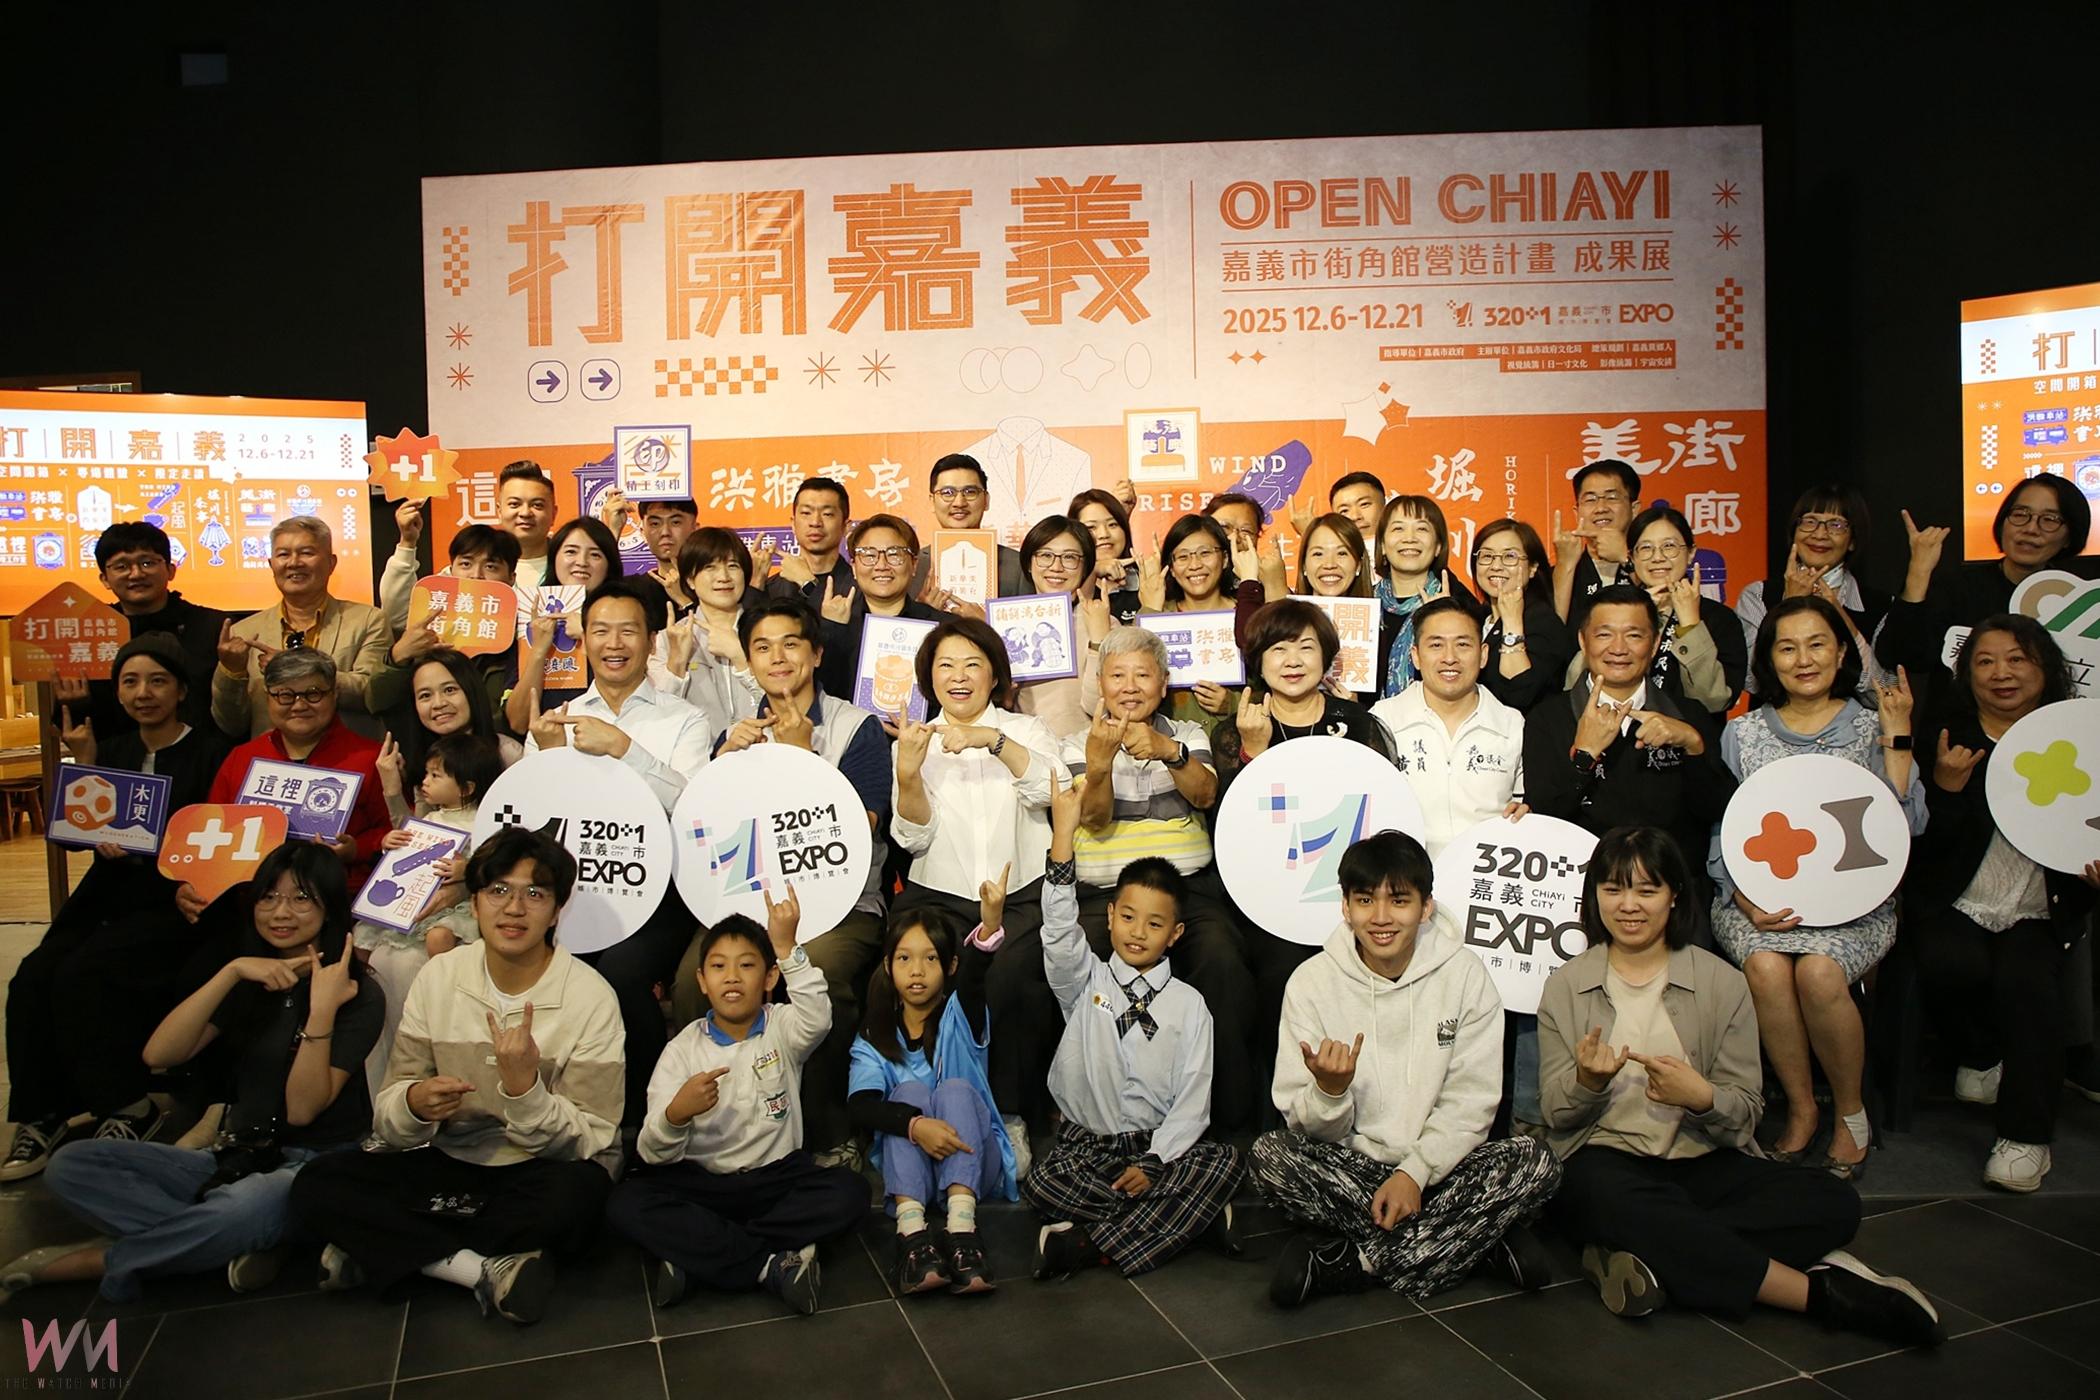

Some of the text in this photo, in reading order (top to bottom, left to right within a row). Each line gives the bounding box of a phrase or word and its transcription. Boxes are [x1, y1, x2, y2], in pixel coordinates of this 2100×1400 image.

[1219, 169, 1670, 231] OPEN CHIAYI
[508, 175, 1150, 347] 打開嘉義
[1221, 238, 1671, 282] 嘉義市街角館營造計畫 成果展
[1222, 303, 1424, 333] 2025 12.6-12.21
[1619, 303, 1674, 324] EXPO
[238, 448, 315, 460] 12.6-12.21
[390, 453, 437, 482] +1
[1208, 454, 1287, 475] WIND
[708, 457, 910, 512] 洪雅書房
[428, 590, 501, 616] 嘉義市
[24, 617, 80, 640] 打開
[1333, 603, 1371, 642] 開
[67, 641, 120, 663] 嘉義
[254, 774, 303, 800] 這裡
[130, 783, 151, 822] 木更
[186, 815, 265, 861] +1
[579, 841, 608, 857] 嘉義
[775, 831, 806, 849] 嘉義
[577, 857, 647, 887] EXPO
[778, 841, 849, 876] EXPO
[1469, 877, 1525, 907] 嘉義
[1463, 904, 1591, 962] EXPO
